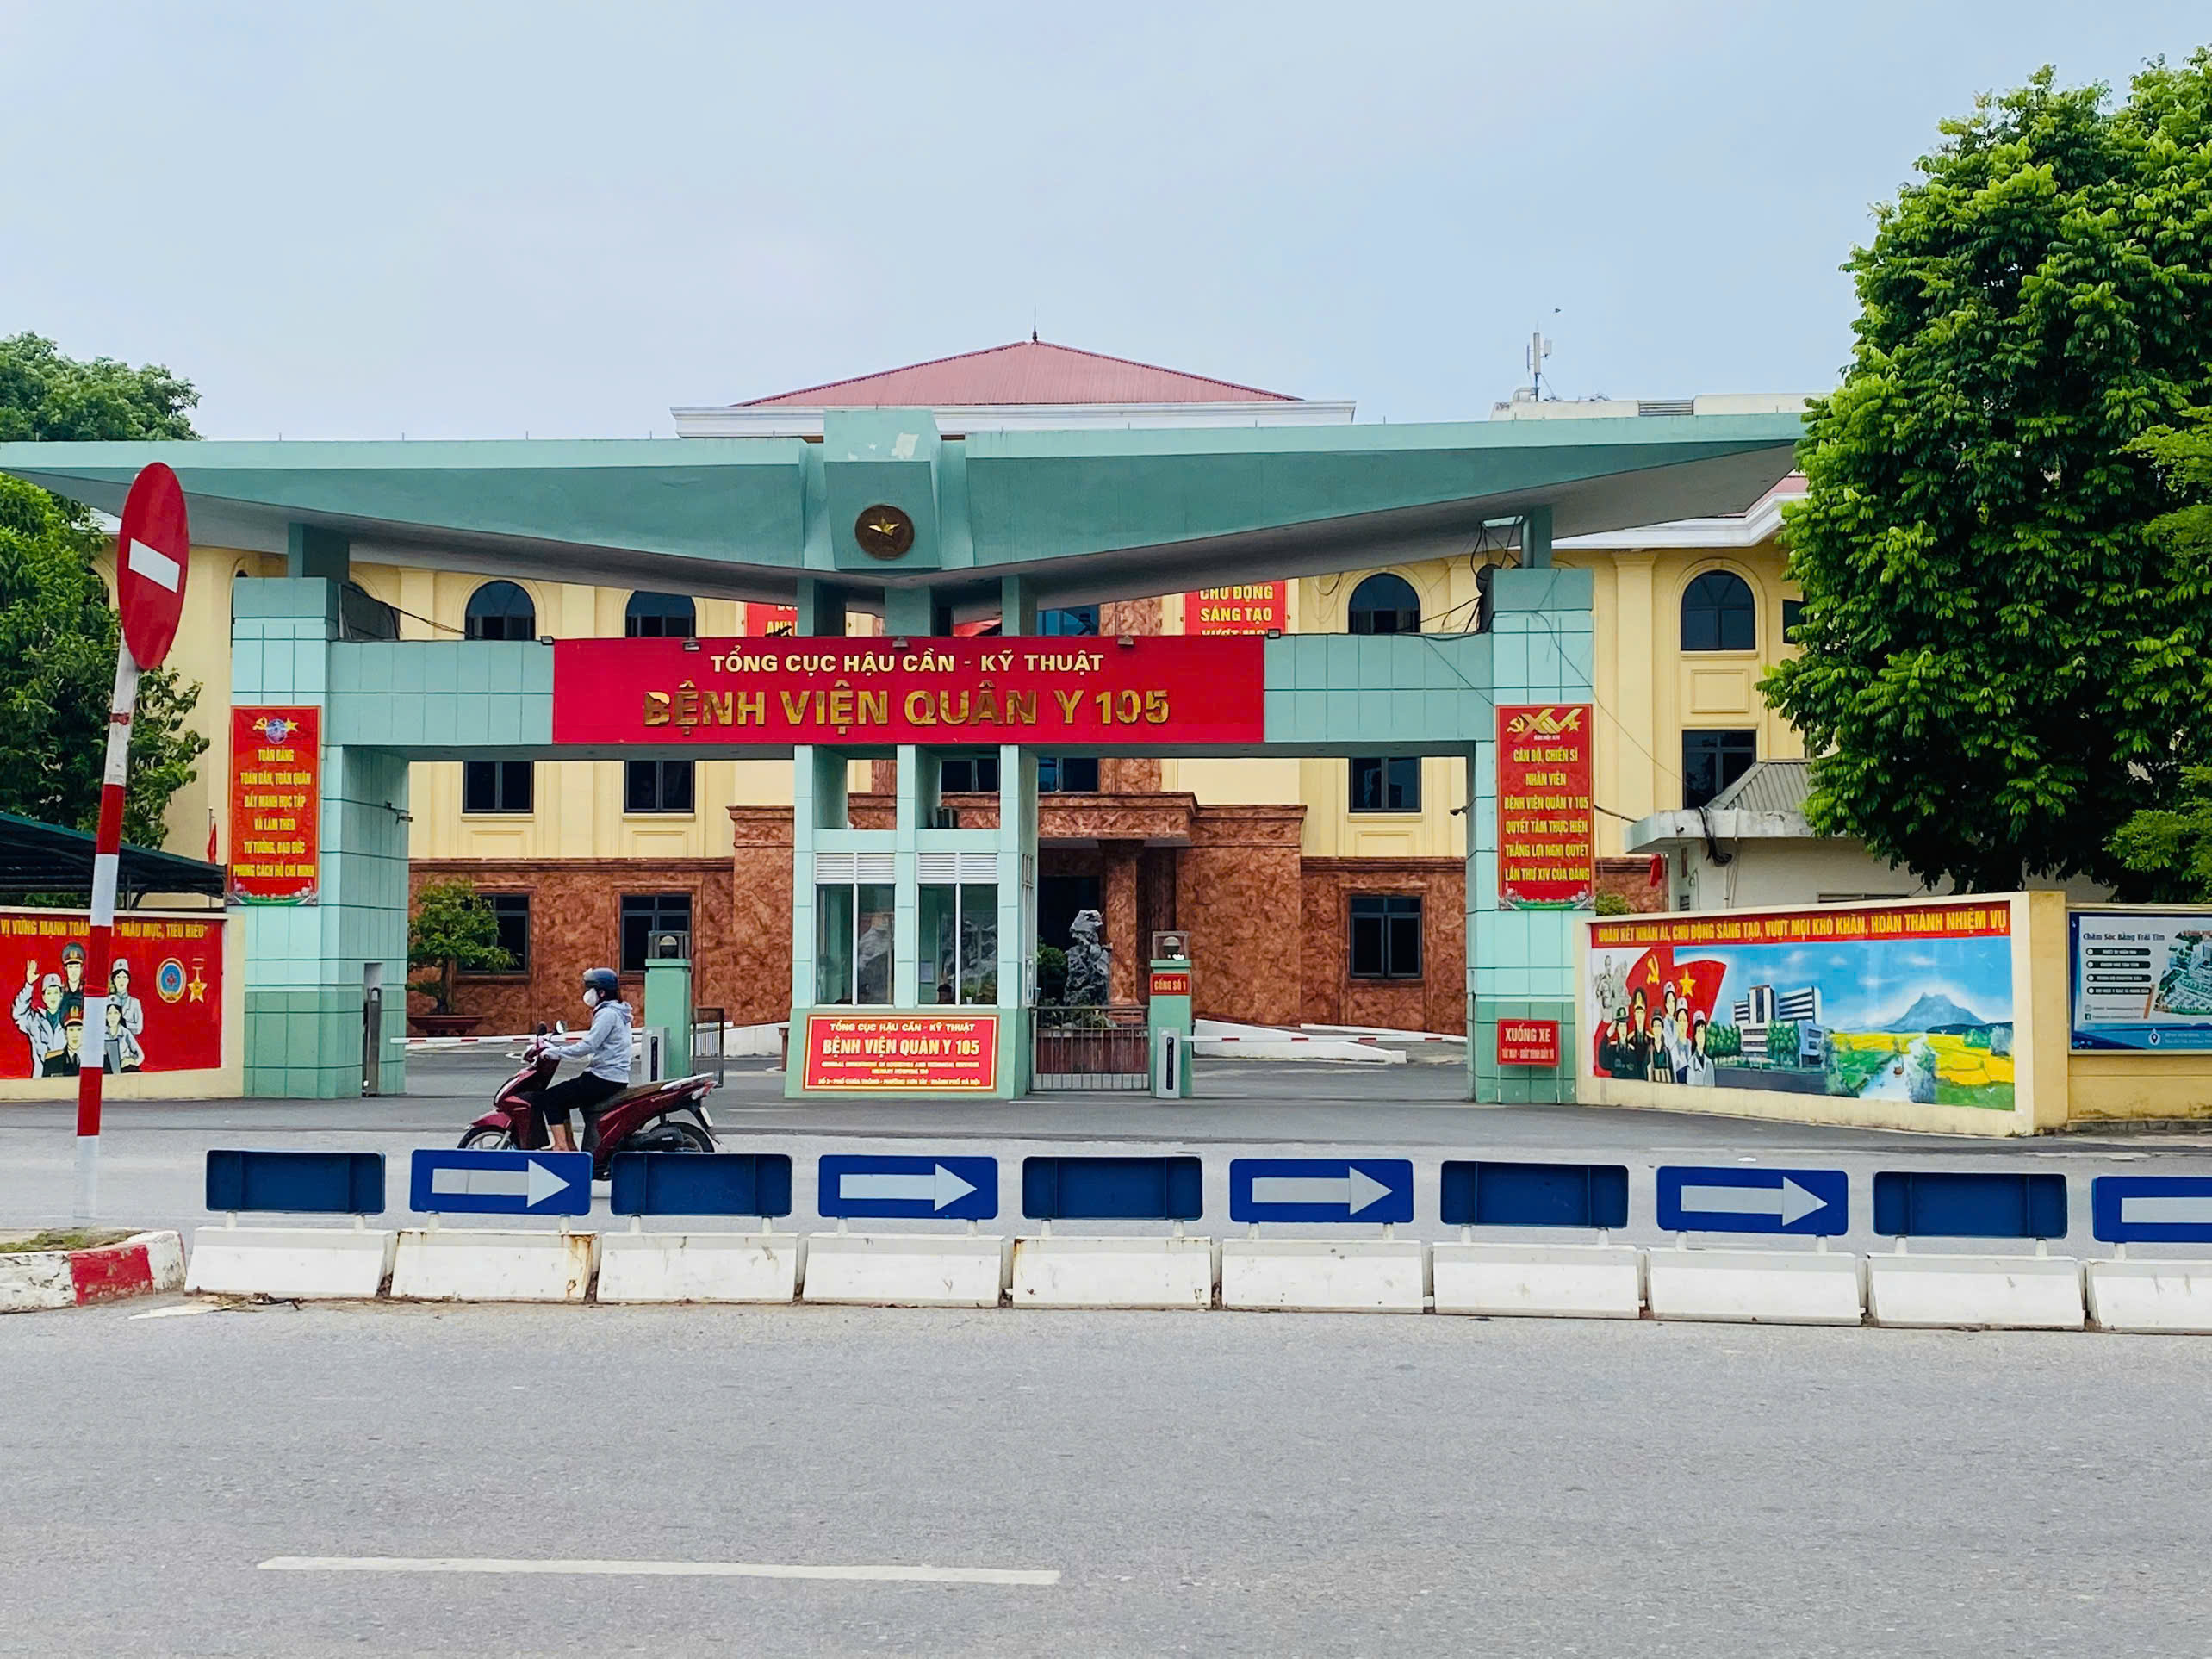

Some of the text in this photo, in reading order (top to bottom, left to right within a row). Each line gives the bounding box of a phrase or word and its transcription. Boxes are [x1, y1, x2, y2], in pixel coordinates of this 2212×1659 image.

[1200, 605, 1272, 624] SÁNG TẠO
[711, 645, 778, 673] TỔNG
[785, 653, 836, 677] CỤC
[843, 650, 895, 677] HẬU
[902, 648, 955, 673] CẦN
[980, 649, 1014, 672] KỸ
[1024, 649, 1104, 676] THUẬT
[643, 679, 1170, 736] BỆNH VIỆN QUÂN Y 105
[1620, 924, 1634, 941] KẾT
[1691, 921, 1714, 943] ĐỘNG
[1717, 921, 1741, 939] SÁNG
[1743, 921, 1763, 941] TẠO,
[1765, 919, 1789, 941] VƯỢT
[1791, 918, 1810, 941] MỌI
[1812, 915, 1834, 935] KHÓ
[1836, 914, 1868, 936] KHĂN,
[1871, 913, 1902, 933] HOÀN
[1904, 910, 1943, 931] THÀNH
[1947, 907, 1986, 934] NHIỆM
[1990, 909, 2007, 933] VỤ
[830, 1020, 855, 1032] TỔNG
[857, 1022, 876, 1033] CỤC
[879, 1022, 898, 1034] HẬU
[902, 1021, 922, 1032] CẦN
[929, 1021, 942, 1032] KỸ
[946, 1022, 975, 1034] THUẬT
[1505, 1022, 1550, 1042] XUỐNG XE
[823, 1035, 979, 1058] BỆNH VIỆN QUÂN Y 105
